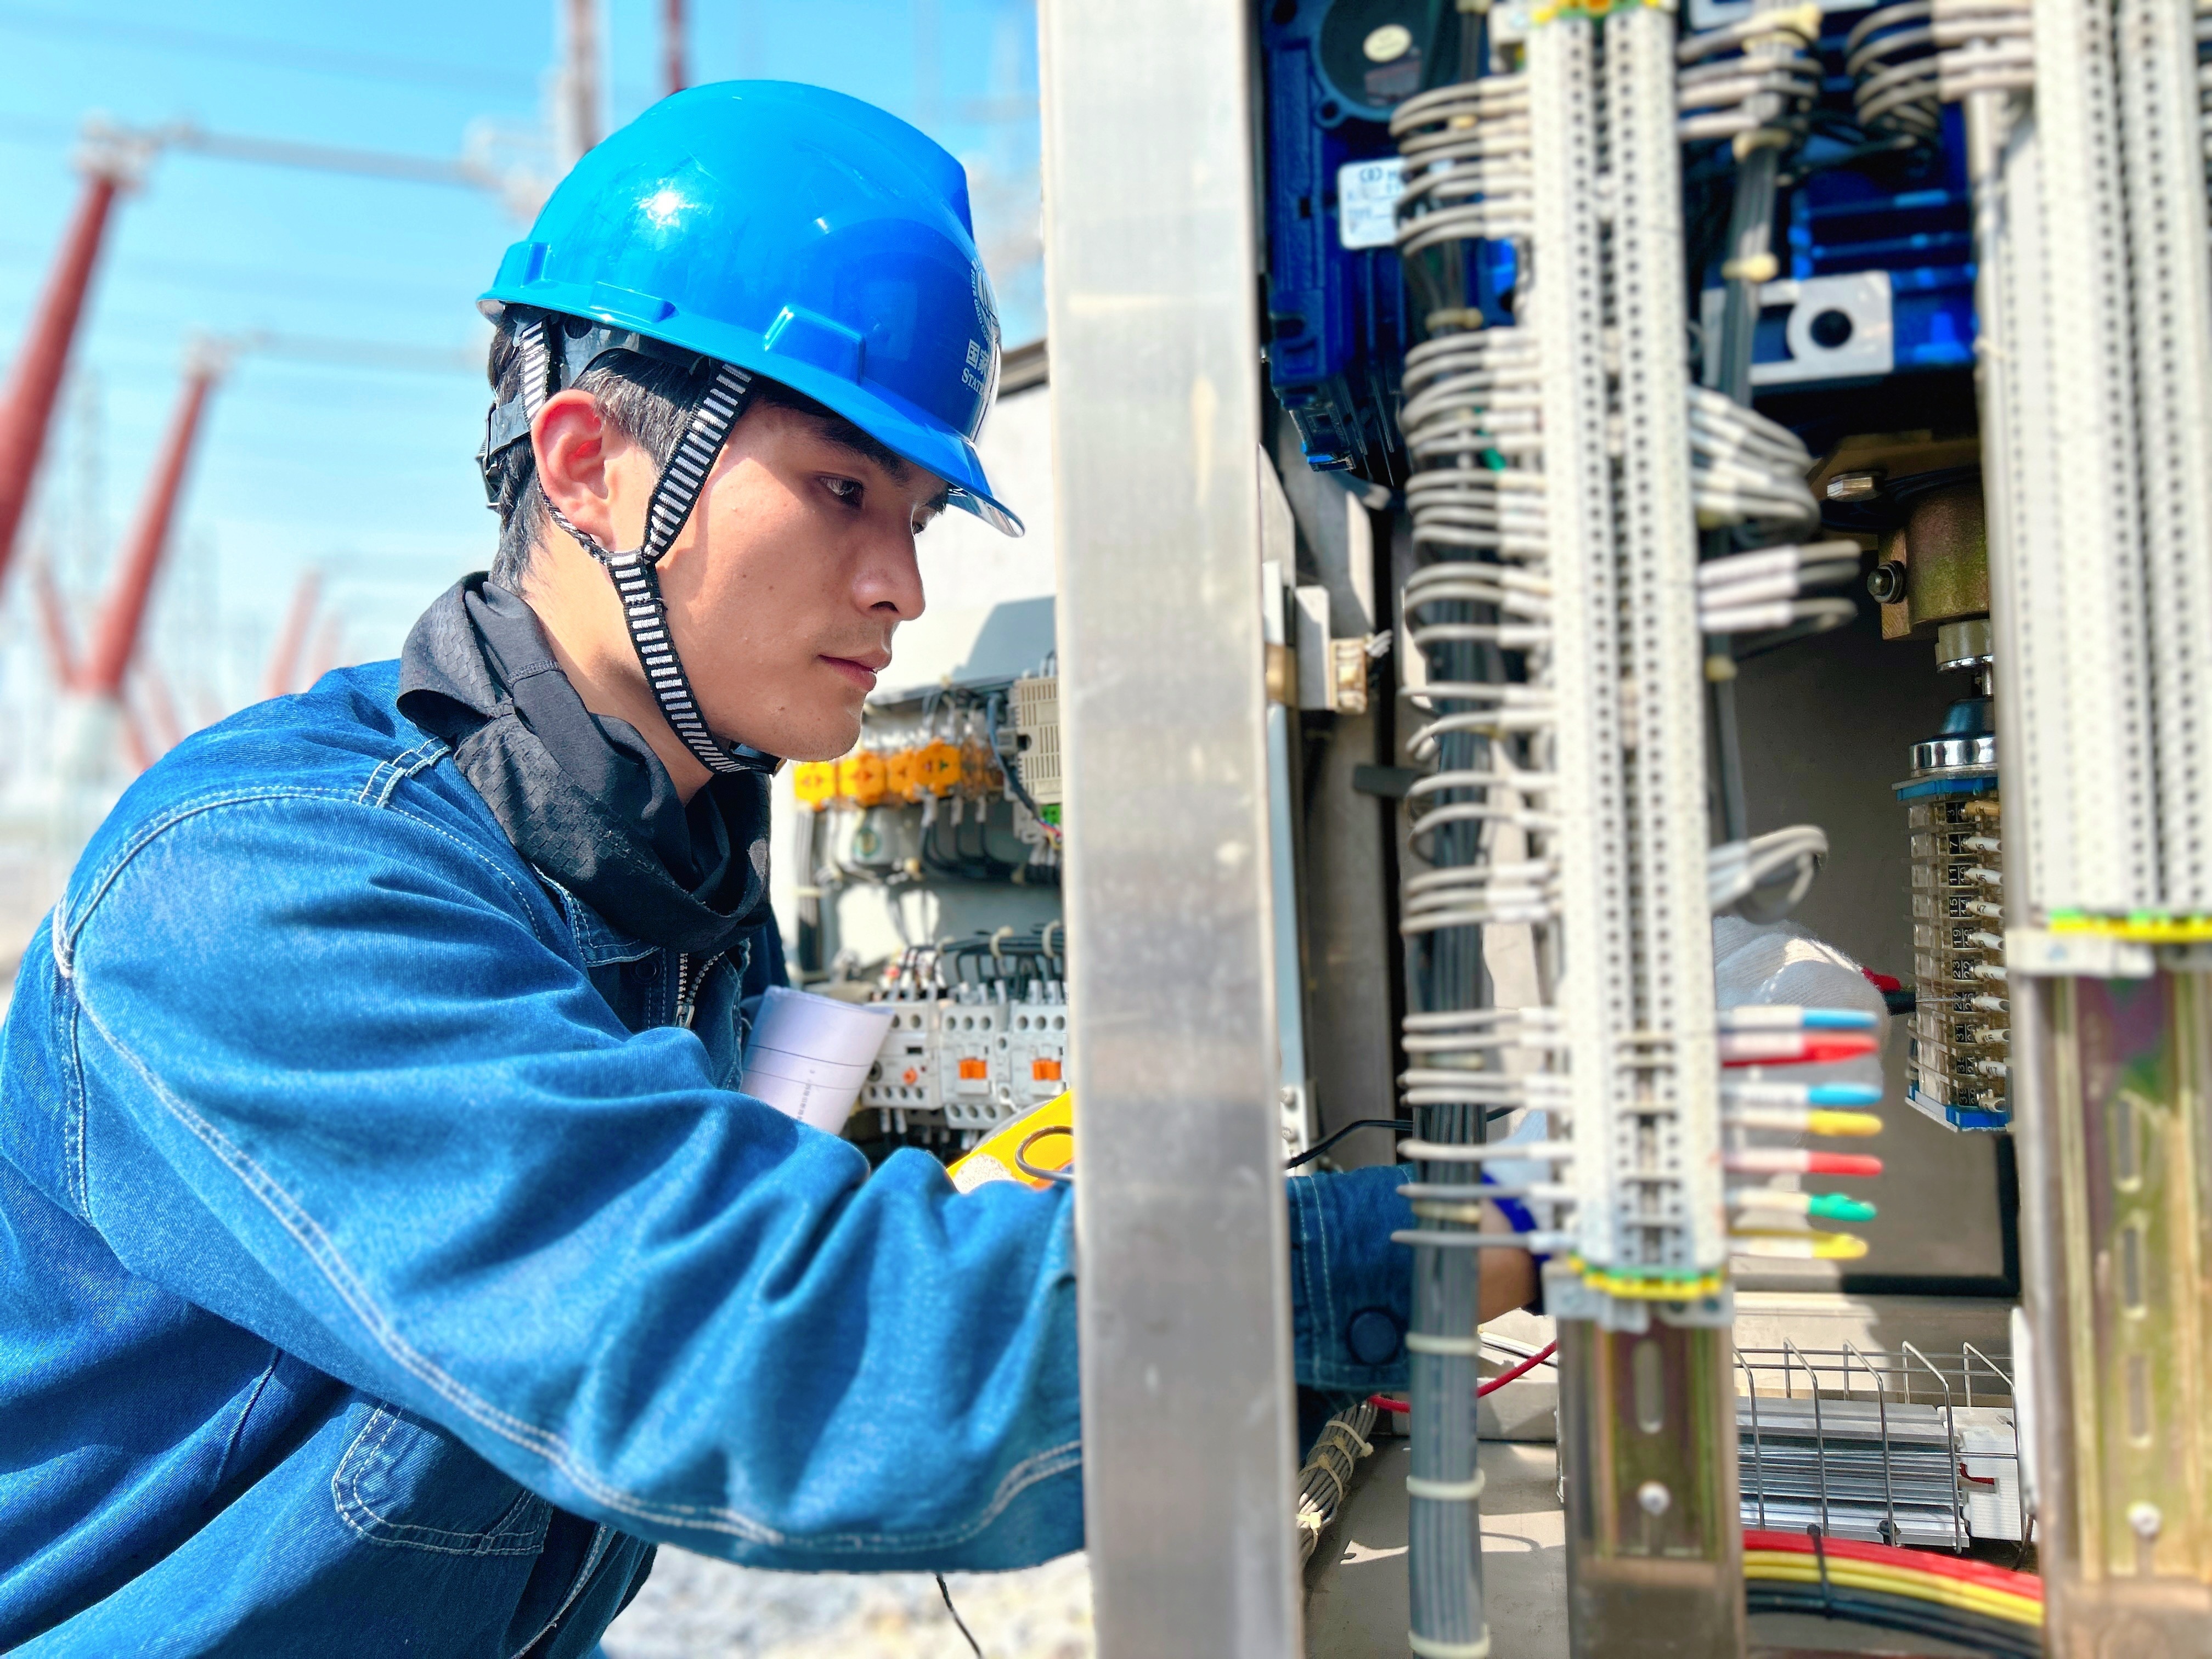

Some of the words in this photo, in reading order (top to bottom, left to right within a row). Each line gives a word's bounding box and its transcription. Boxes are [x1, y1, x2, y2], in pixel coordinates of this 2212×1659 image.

[974, 298, 983, 324] GRID
[1949, 868, 1957, 883] 11
[1949, 898, 1959, 915] 15
[1953, 929, 1962, 945] 19
[1953, 961, 1961, 979] 23
[1955, 1025, 1965, 1041] 31
